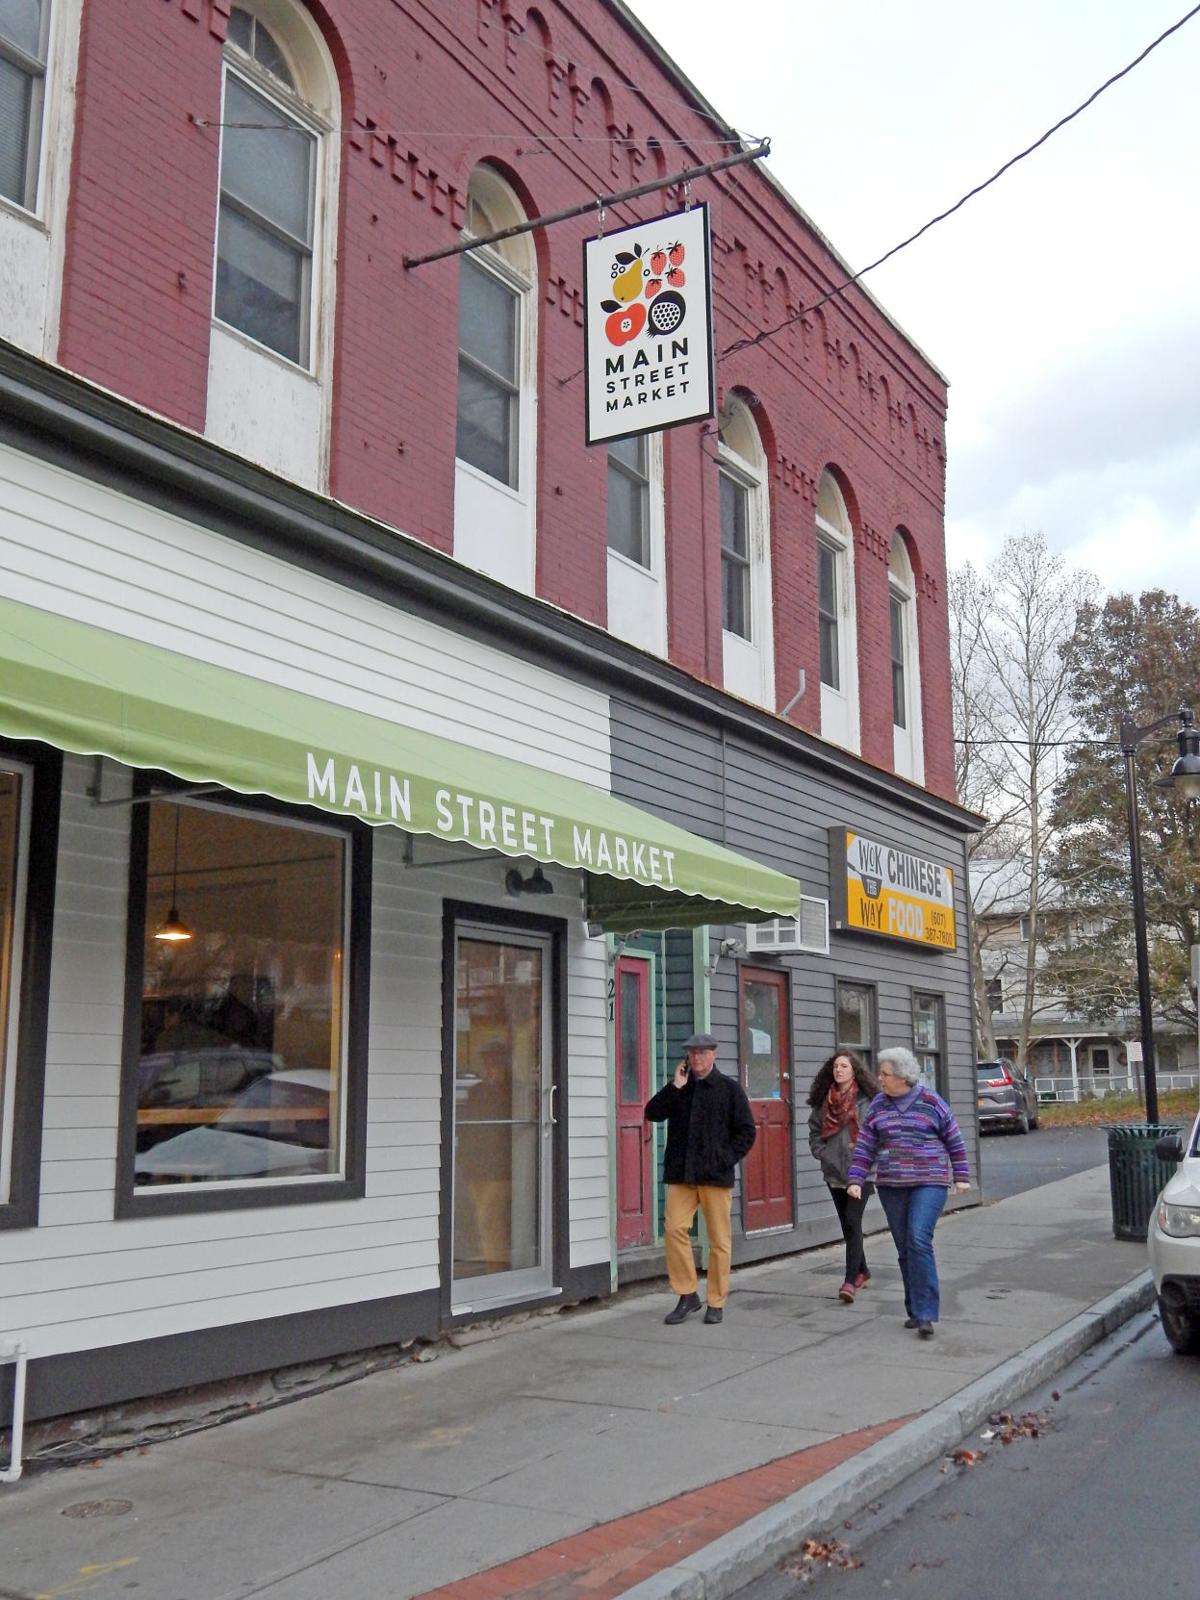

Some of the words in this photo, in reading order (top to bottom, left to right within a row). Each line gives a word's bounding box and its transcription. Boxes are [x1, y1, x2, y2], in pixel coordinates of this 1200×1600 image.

[605, 337, 689, 376] MAIN
[606, 362, 689, 394] STREET
[606, 381, 690, 413] MARKET
[306, 752, 411, 823] MAIN
[435, 789, 554, 856] STREET
[572, 825, 675, 884] MARKET
[887, 850, 942, 898] CHINESE
[860, 898, 883, 929] WAY
[888, 897, 924, 938] FOOD
